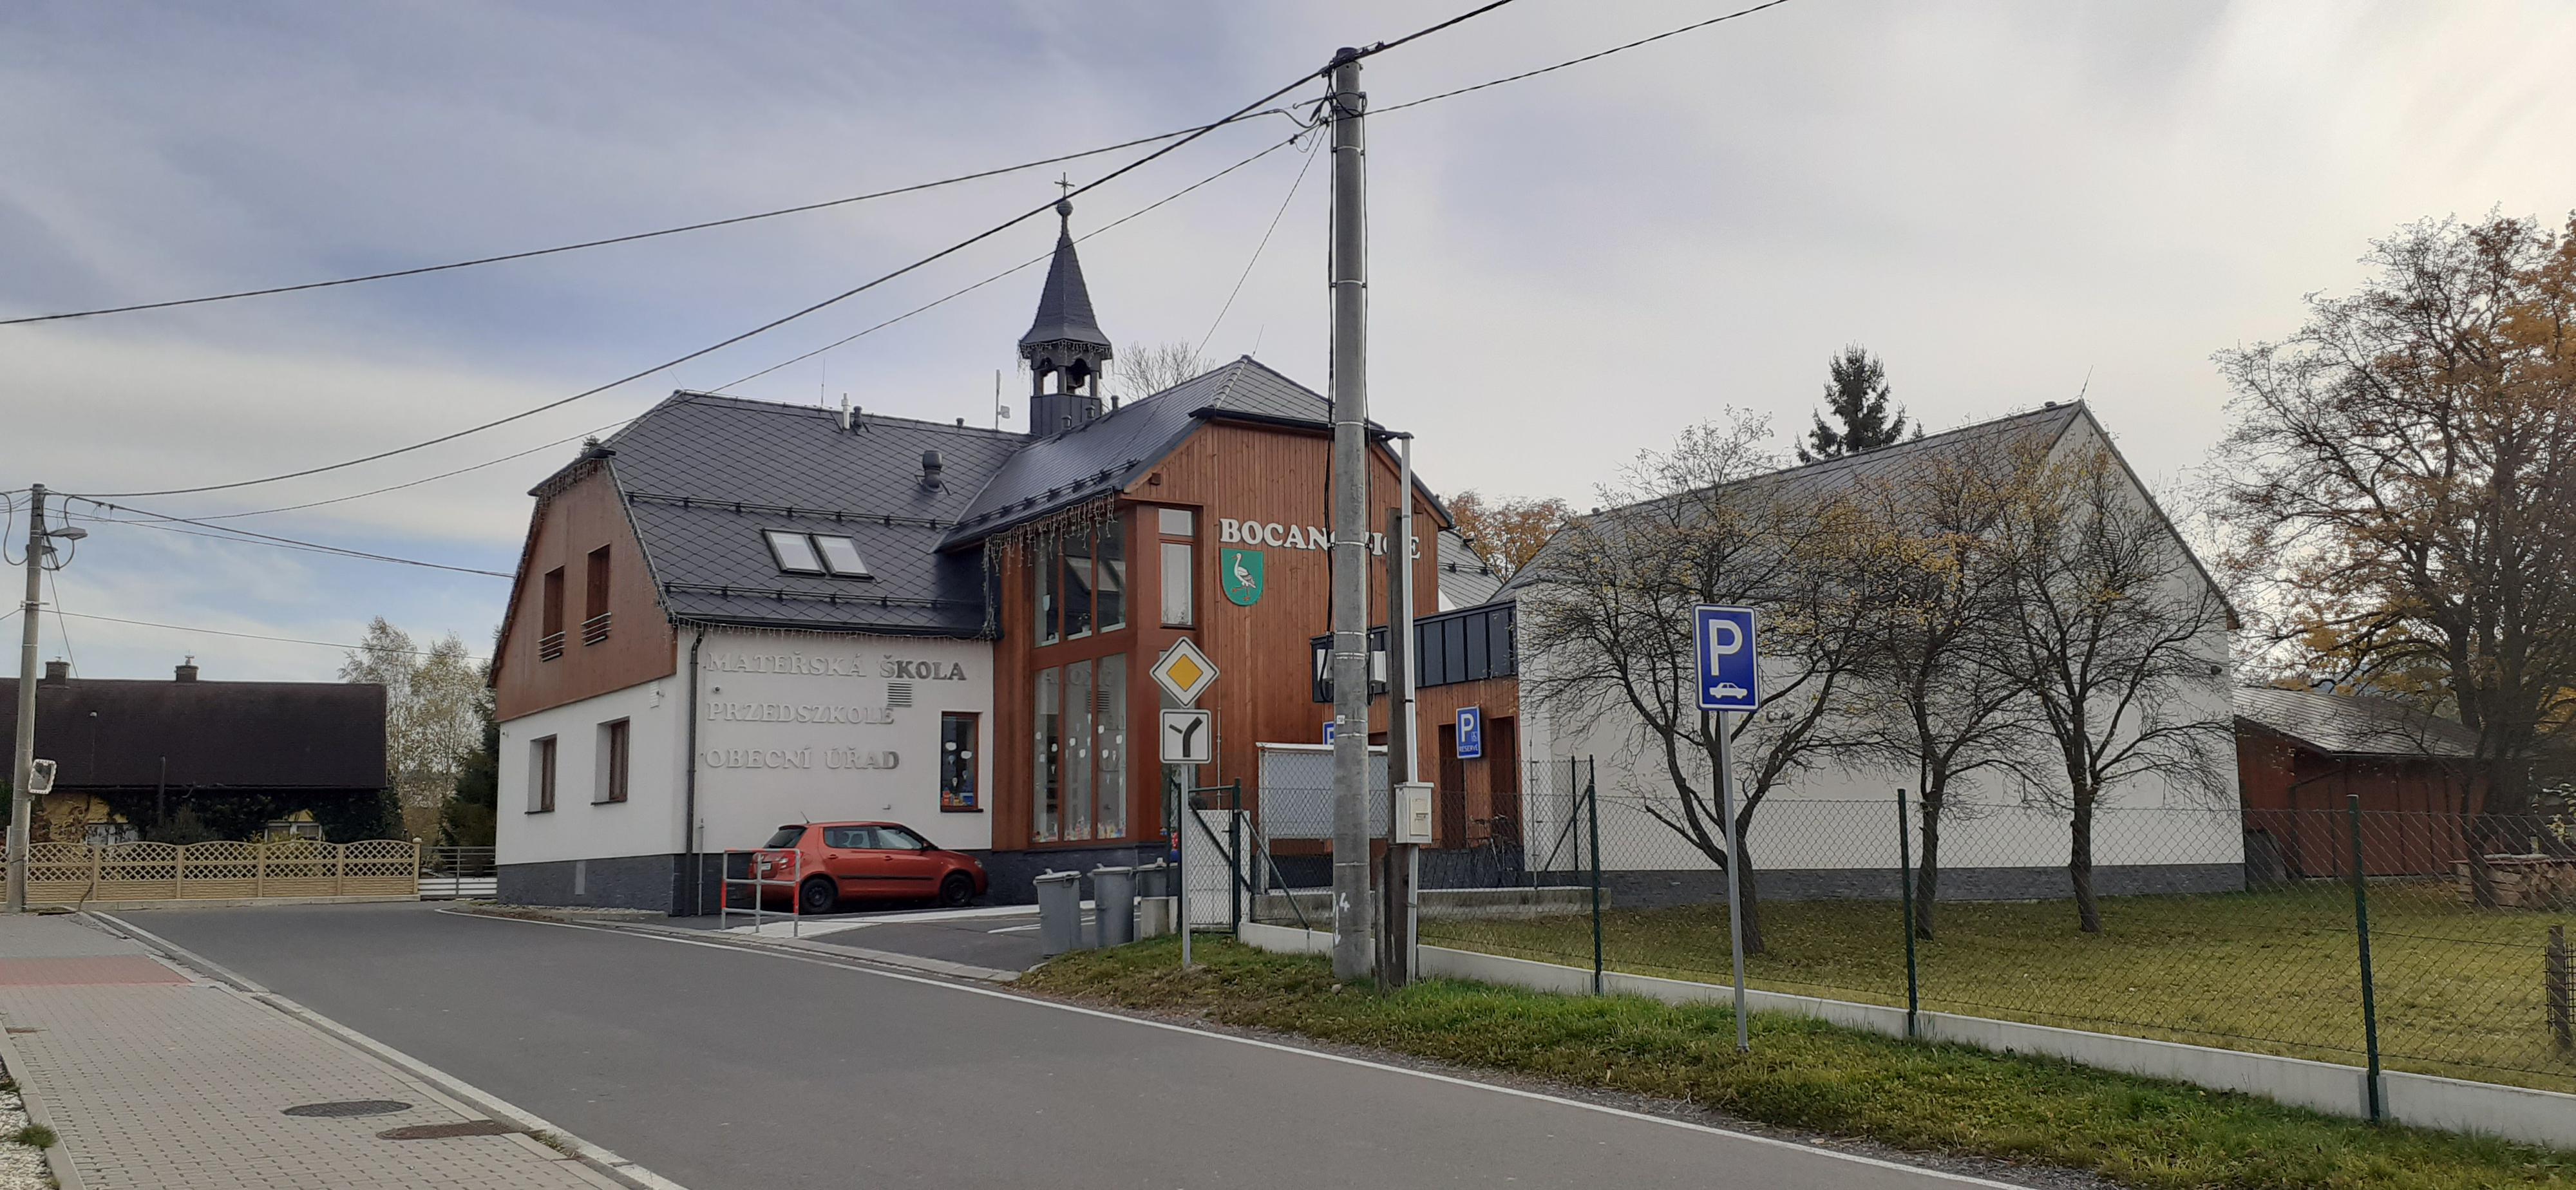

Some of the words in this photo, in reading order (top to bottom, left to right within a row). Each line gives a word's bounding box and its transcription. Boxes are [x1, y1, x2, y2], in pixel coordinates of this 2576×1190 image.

[1220, 518, 1421, 560] BOCANIE
[1709, 619, 1743, 675] P
[708, 651, 866, 677] MATEŘSKÁ
[879, 654, 967, 681] ŠKOLA
[706, 702, 894, 724] PRZEDSZKOLE
[1461, 713, 1474, 742] P
[705, 747, 813, 769] OBECNÍ
[825, 747, 900, 770] ÚŘAD
[1340, 892, 1350, 912] 4
